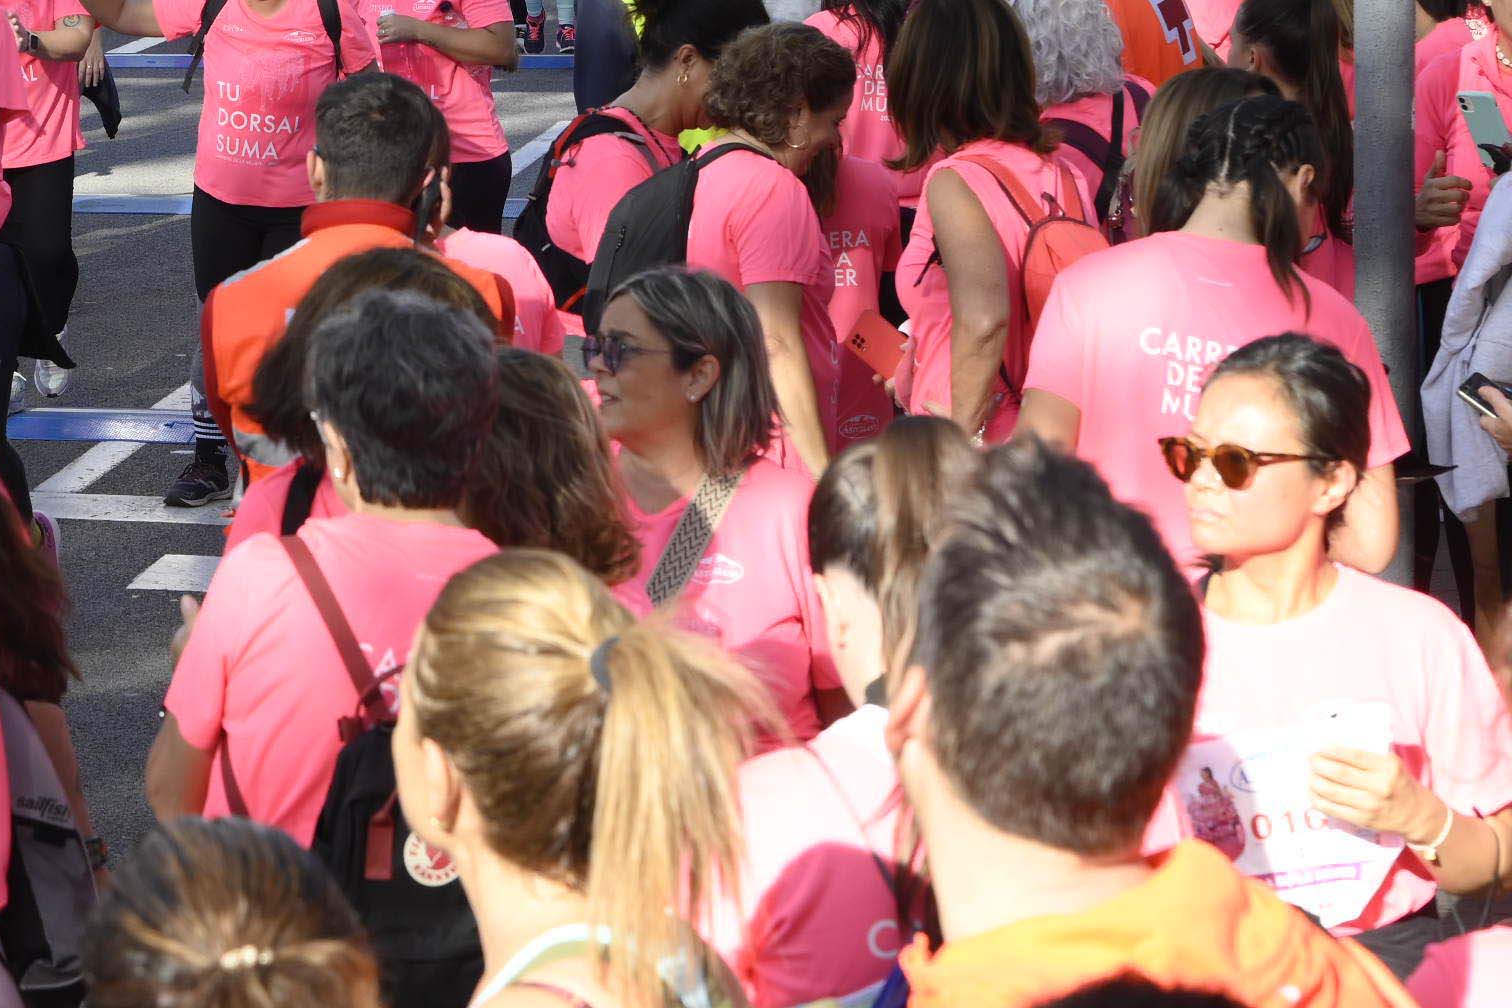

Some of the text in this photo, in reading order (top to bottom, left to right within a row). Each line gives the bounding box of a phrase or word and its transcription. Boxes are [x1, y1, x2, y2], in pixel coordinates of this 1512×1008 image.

[217, 80, 241, 102] TU
[864, 80, 886, 96] DE
[216, 135, 279, 160] SUMA
[1166, 360, 1204, 393] DE
